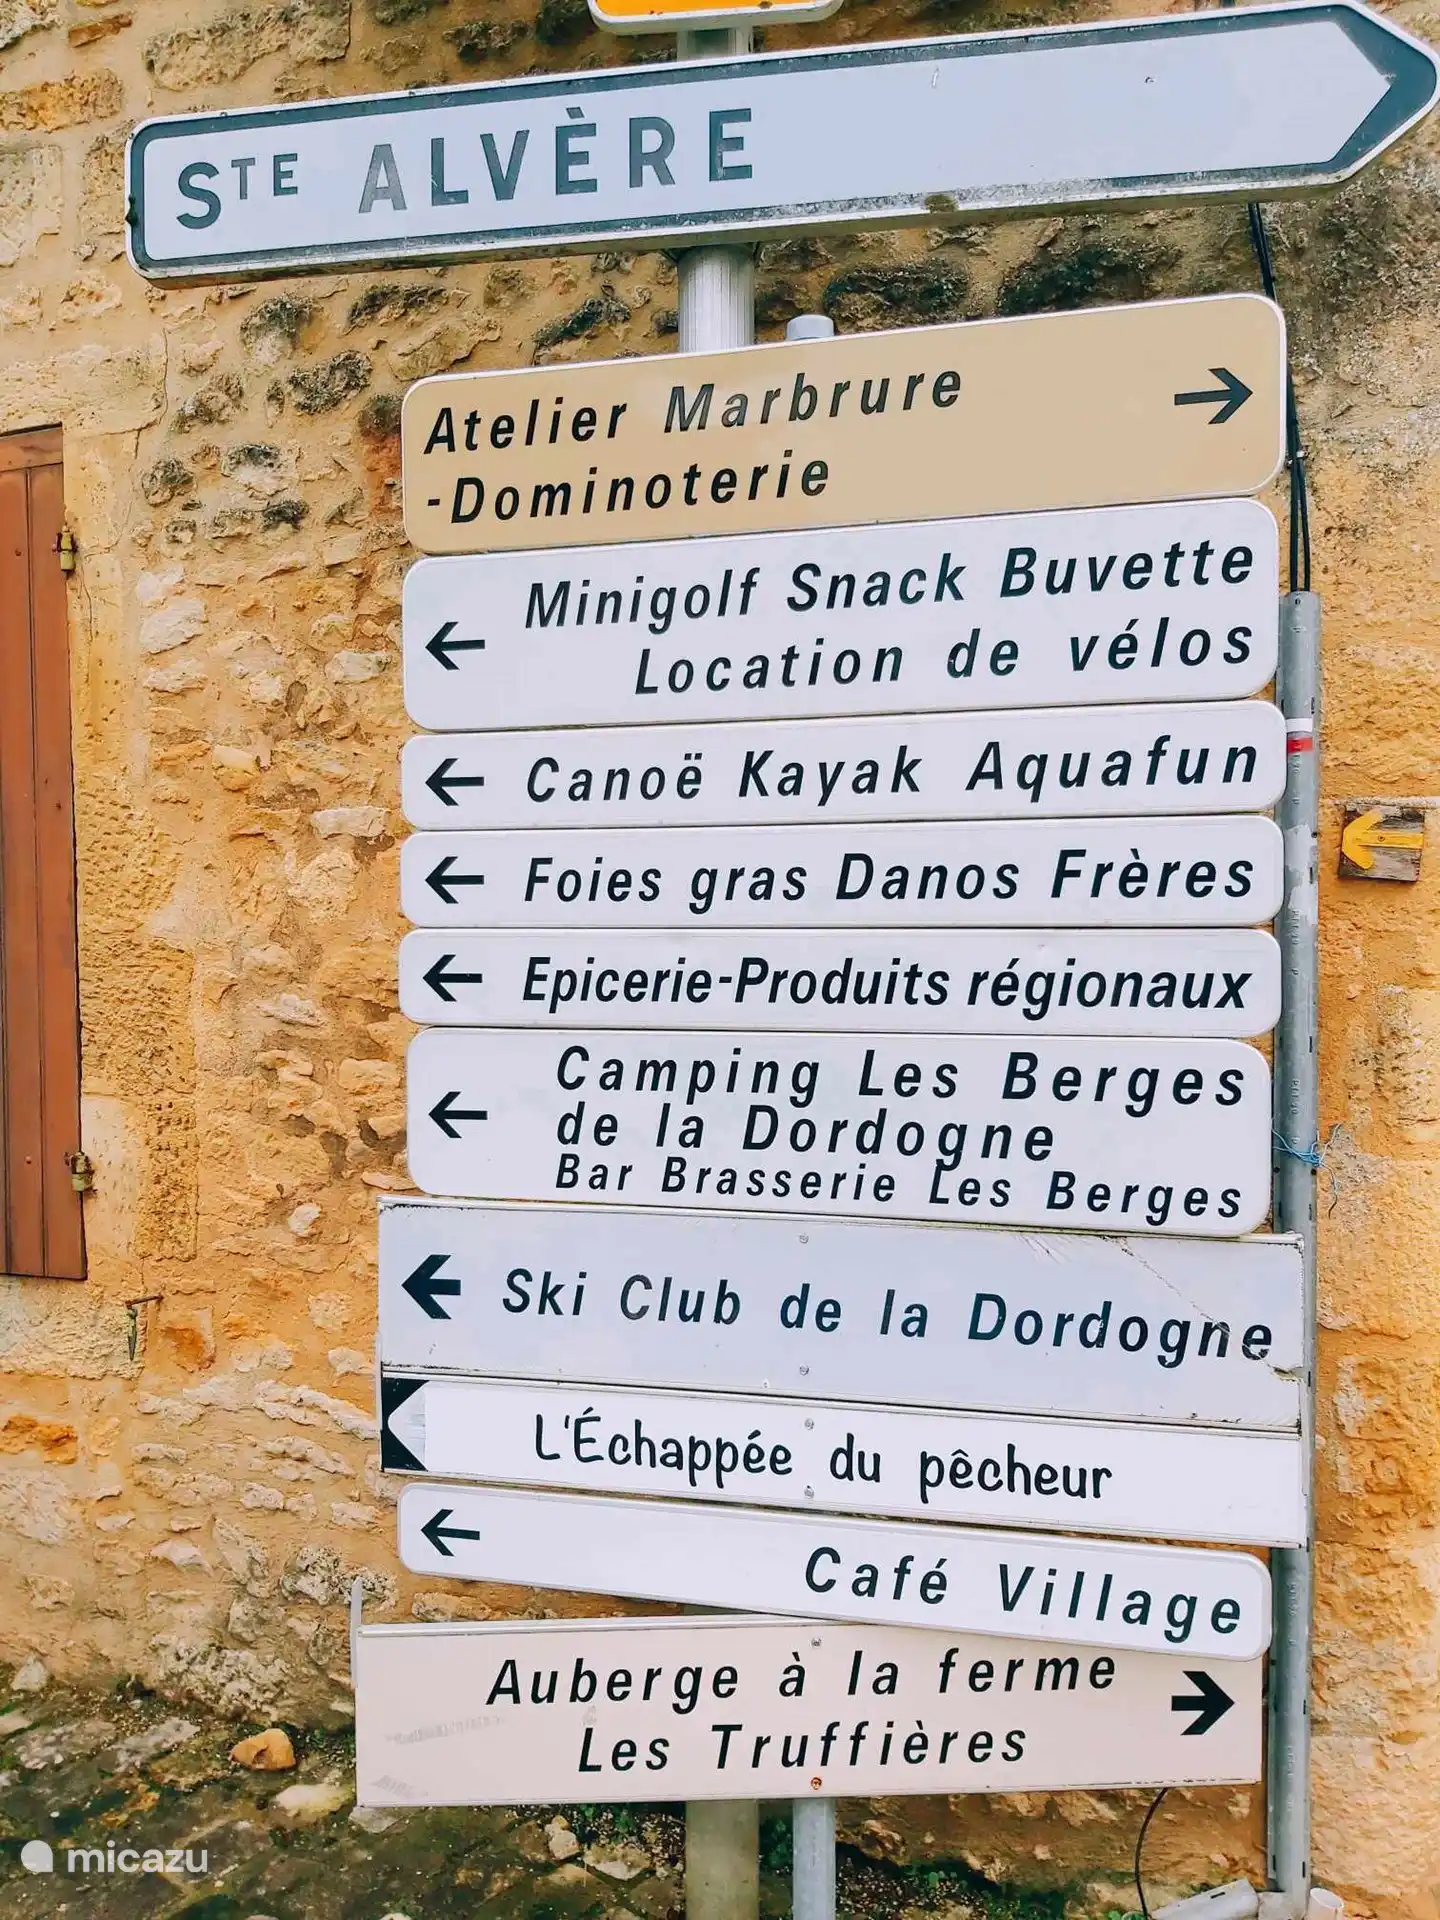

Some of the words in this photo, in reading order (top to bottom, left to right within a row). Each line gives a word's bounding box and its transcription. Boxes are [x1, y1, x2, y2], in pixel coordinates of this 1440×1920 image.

[359, 106, 752, 213] ALVÈRE
[424, 397, 627, 454] Atelier
[664, 371, 960, 433] Marbrure
[428, 450, 828, 523] -Dominoterie
[526, 567, 760, 634] Minigolf
[787, 553, 966, 612] Snack
[1000, 540, 1252, 598] Buvette
[635, 638, 902, 694] Location
[947, 628, 1018, 678] de
[1071, 617, 1252, 671] vélos
[527, 753, 702, 802] Canoë
[739, 745, 922, 806] Kayak
[965, 735, 1256, 803] Aquafun
[525, 857, 661, 902] Foies
[689, 867, 807, 914] gras
[836, 853, 1019, 899] Danos
[1051, 848, 1253, 898] Frères
[523, 957, 949, 1013] Epicerie-Produits
[968, 958, 1252, 1021] régionaux
[557, 1046, 819, 1108] Camping
[859, 1050, 957, 1098] Les
[1002, 1052, 1243, 1117] Berges
[557, 1101, 617, 1146] de
[656, 1103, 703, 1148] la
[743, 1105, 1053, 1169] Dordogne
[556, 1153, 632, 1190] Bar
[662, 1156, 895, 1202] Brasserie
[929, 1167, 1011, 1208] Les
[1047, 1171, 1240, 1226] Berges
[503, 1268, 587, 1316] Ski
[621, 1275, 740, 1325] Club
[781, 1283, 841, 1332] de
[880, 1289, 927, 1337] la
[968, 1293, 1271, 1368] Dordogne
[536, 1407, 792, 1489] L'Échappée
[830, 1433, 880, 1483] du
[920, 1443, 1112, 1504] pêcheur
[806, 1547, 947, 1604] Café
[1000, 1564, 1240, 1643] Village
[486, 1658, 737, 1714] Auberge
[779, 1652, 805, 1697] à
[848, 1651, 898, 1695] la
[939, 1648, 1114, 1693] ferme
[579, 1728, 669, 1772] Les
[712, 1720, 1025, 1769] Truffières
